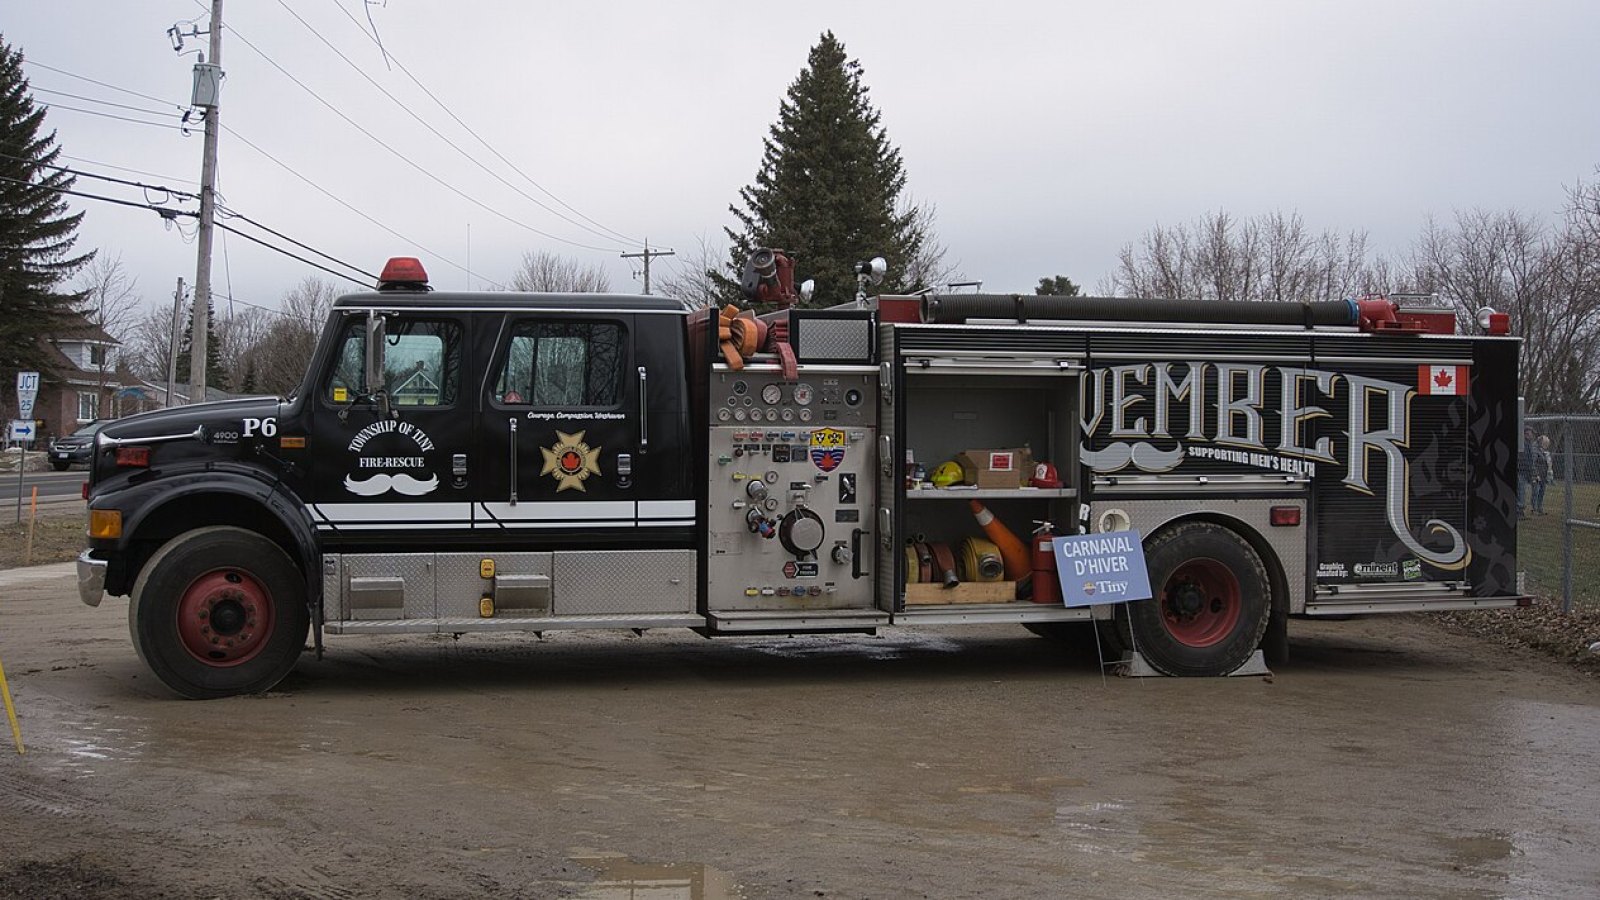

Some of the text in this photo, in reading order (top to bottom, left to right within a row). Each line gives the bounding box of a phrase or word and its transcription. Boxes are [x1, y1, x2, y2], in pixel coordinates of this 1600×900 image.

[19, 375, 37, 389] JCT
[21, 399, 32, 411] 25
[213, 431, 239, 439] 4900
[242, 418, 277, 438] P6
[348, 420, 435, 453] TOWNSHIP OF TINY
[1188, 446, 1315, 478] SUPPORTING MEN'S HEALTH
[1063, 536, 1134, 558] CARNAVAL
[1074, 556, 1129, 576] D'HIVER
[1353, 561, 1399, 575] eminent
[1096, 580, 1128, 595] Tiny
